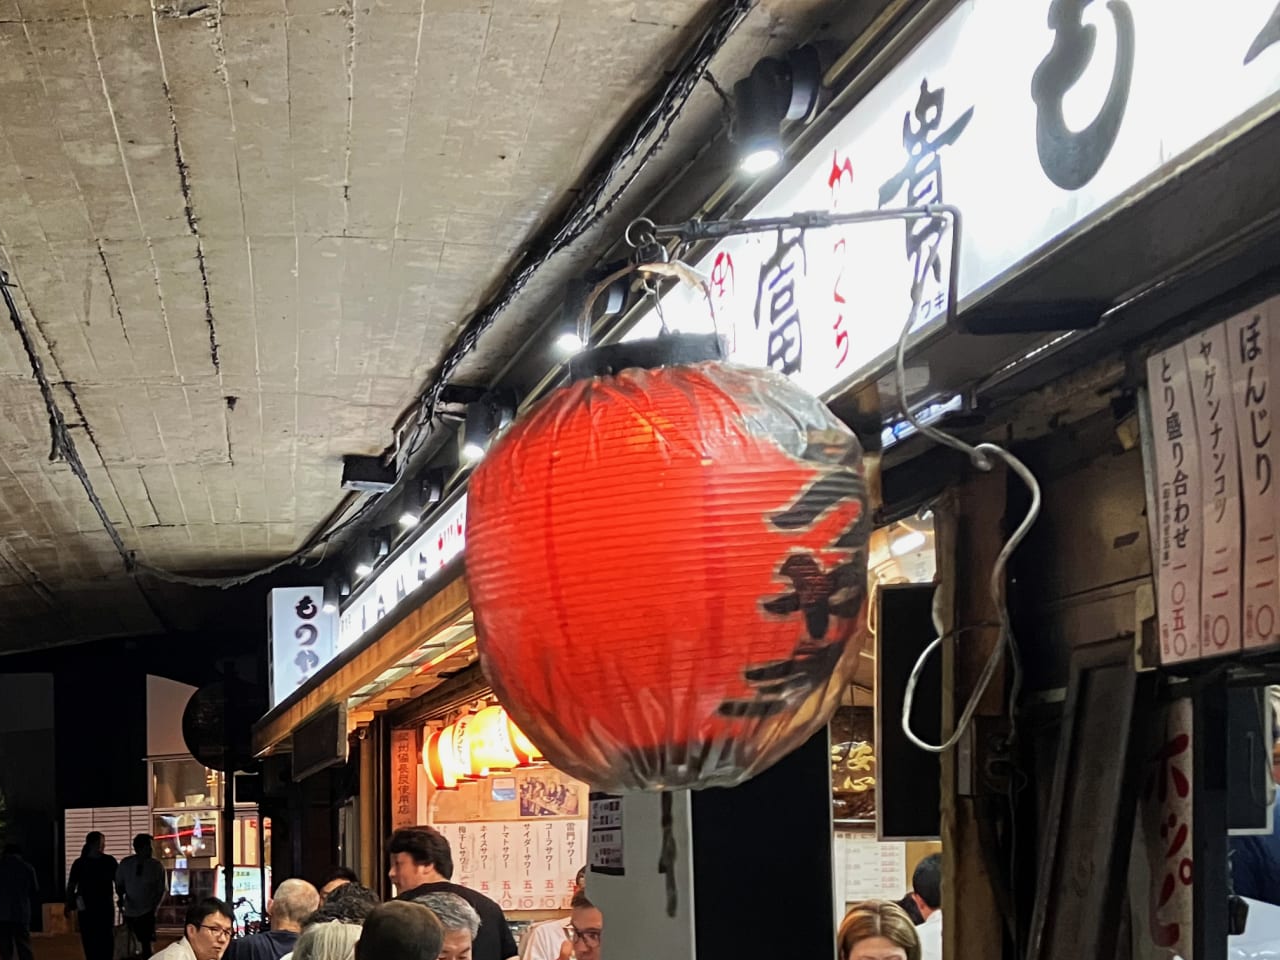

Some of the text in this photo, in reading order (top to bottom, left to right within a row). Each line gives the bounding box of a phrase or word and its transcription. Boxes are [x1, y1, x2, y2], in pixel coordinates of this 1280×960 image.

[1160, 357, 1191, 548] とり盛り合わせ
[293, 595, 320, 690] もつや
[502, 825, 510, 868] トマトサワー
